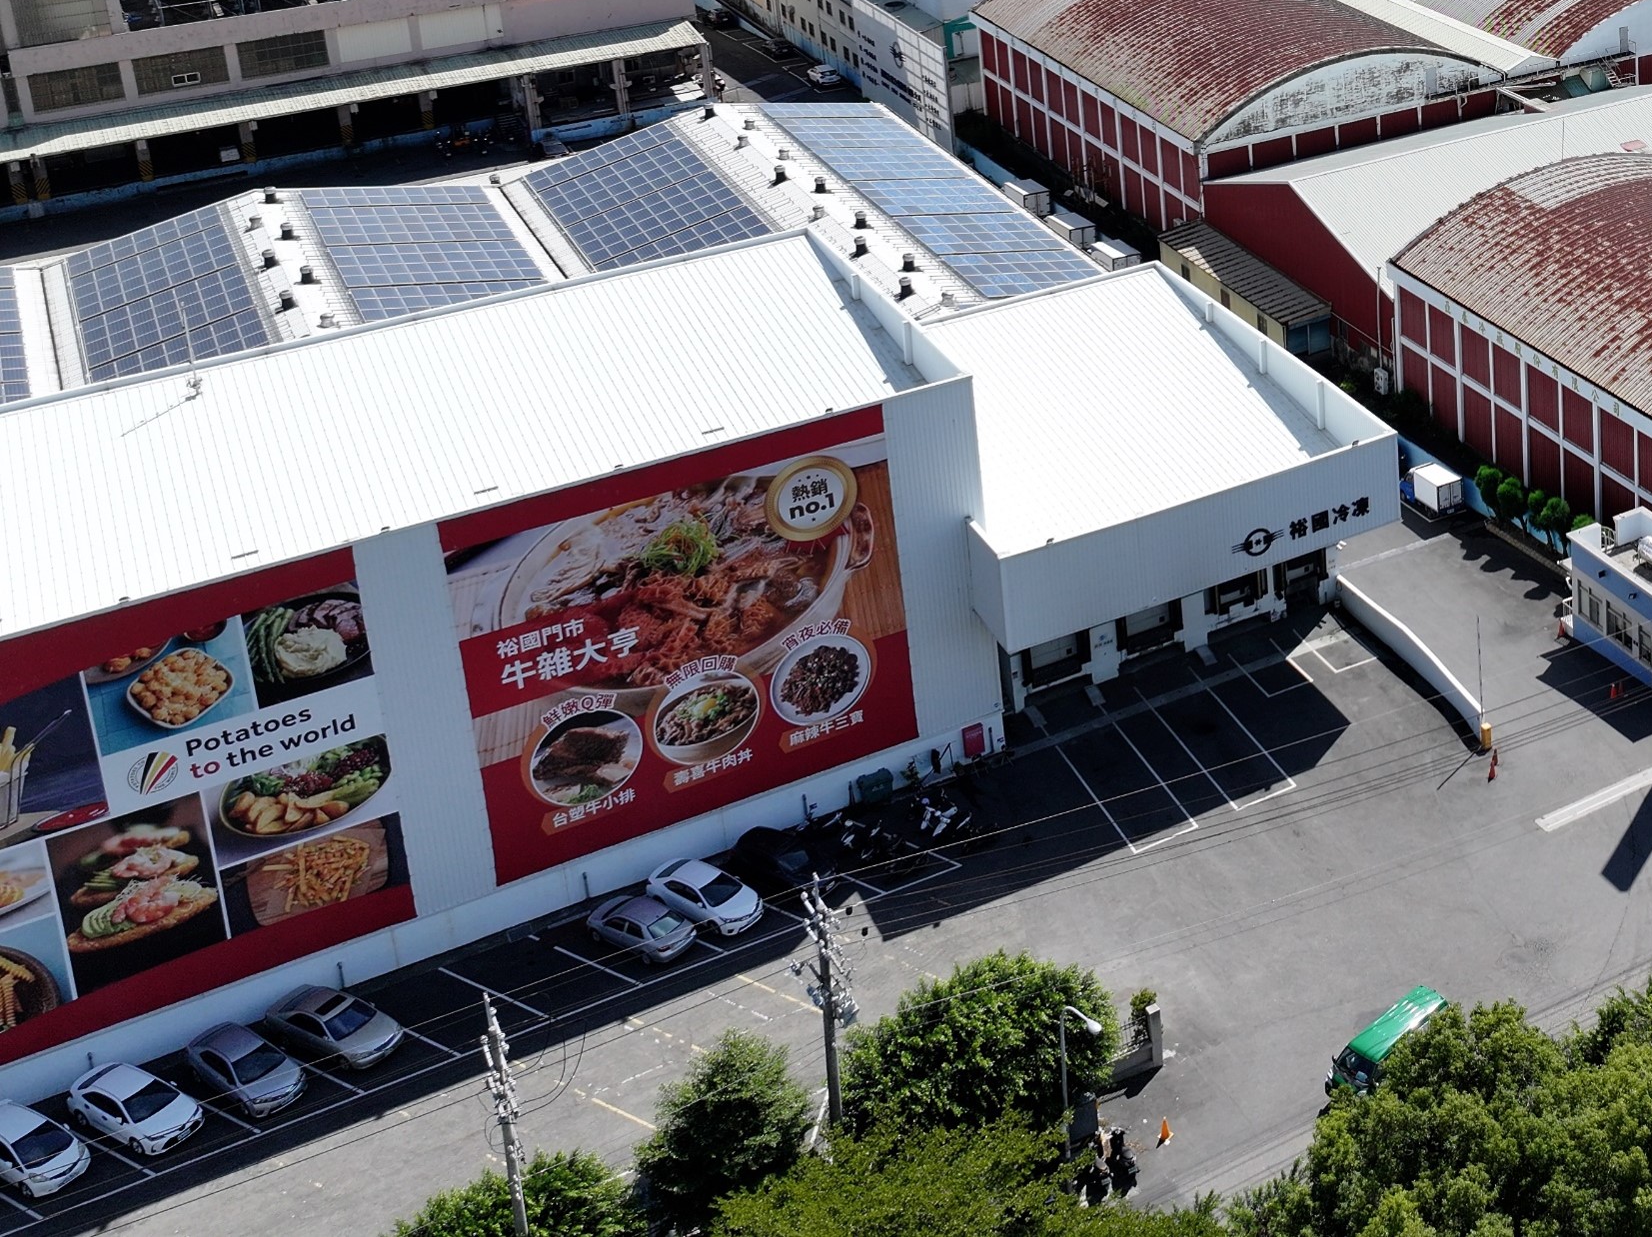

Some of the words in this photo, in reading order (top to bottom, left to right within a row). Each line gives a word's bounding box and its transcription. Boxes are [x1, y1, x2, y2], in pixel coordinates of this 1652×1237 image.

[788, 494, 836, 520] no.1
[790, 477, 829, 502] 熱銷
[1289, 496, 1370, 540] 裕國冷凍
[496, 618, 585, 659] 裕國門市
[780, 619, 851, 654] 宵夜必備
[500, 626, 641, 691] 牛雜大亨
[663, 655, 738, 691] 無限回購
[541, 693, 617, 731] 鮮嫩Q彈
[788, 710, 866, 747] 麻辣牛三寶
[185, 708, 312, 757] Potatoes
[189, 761, 221, 779] to
[226, 744, 274, 768] the
[279, 713, 357, 751] world
[673, 748, 754, 787] 壽喜牛肉丼
[552, 788, 636, 829] 台塑牛小排
